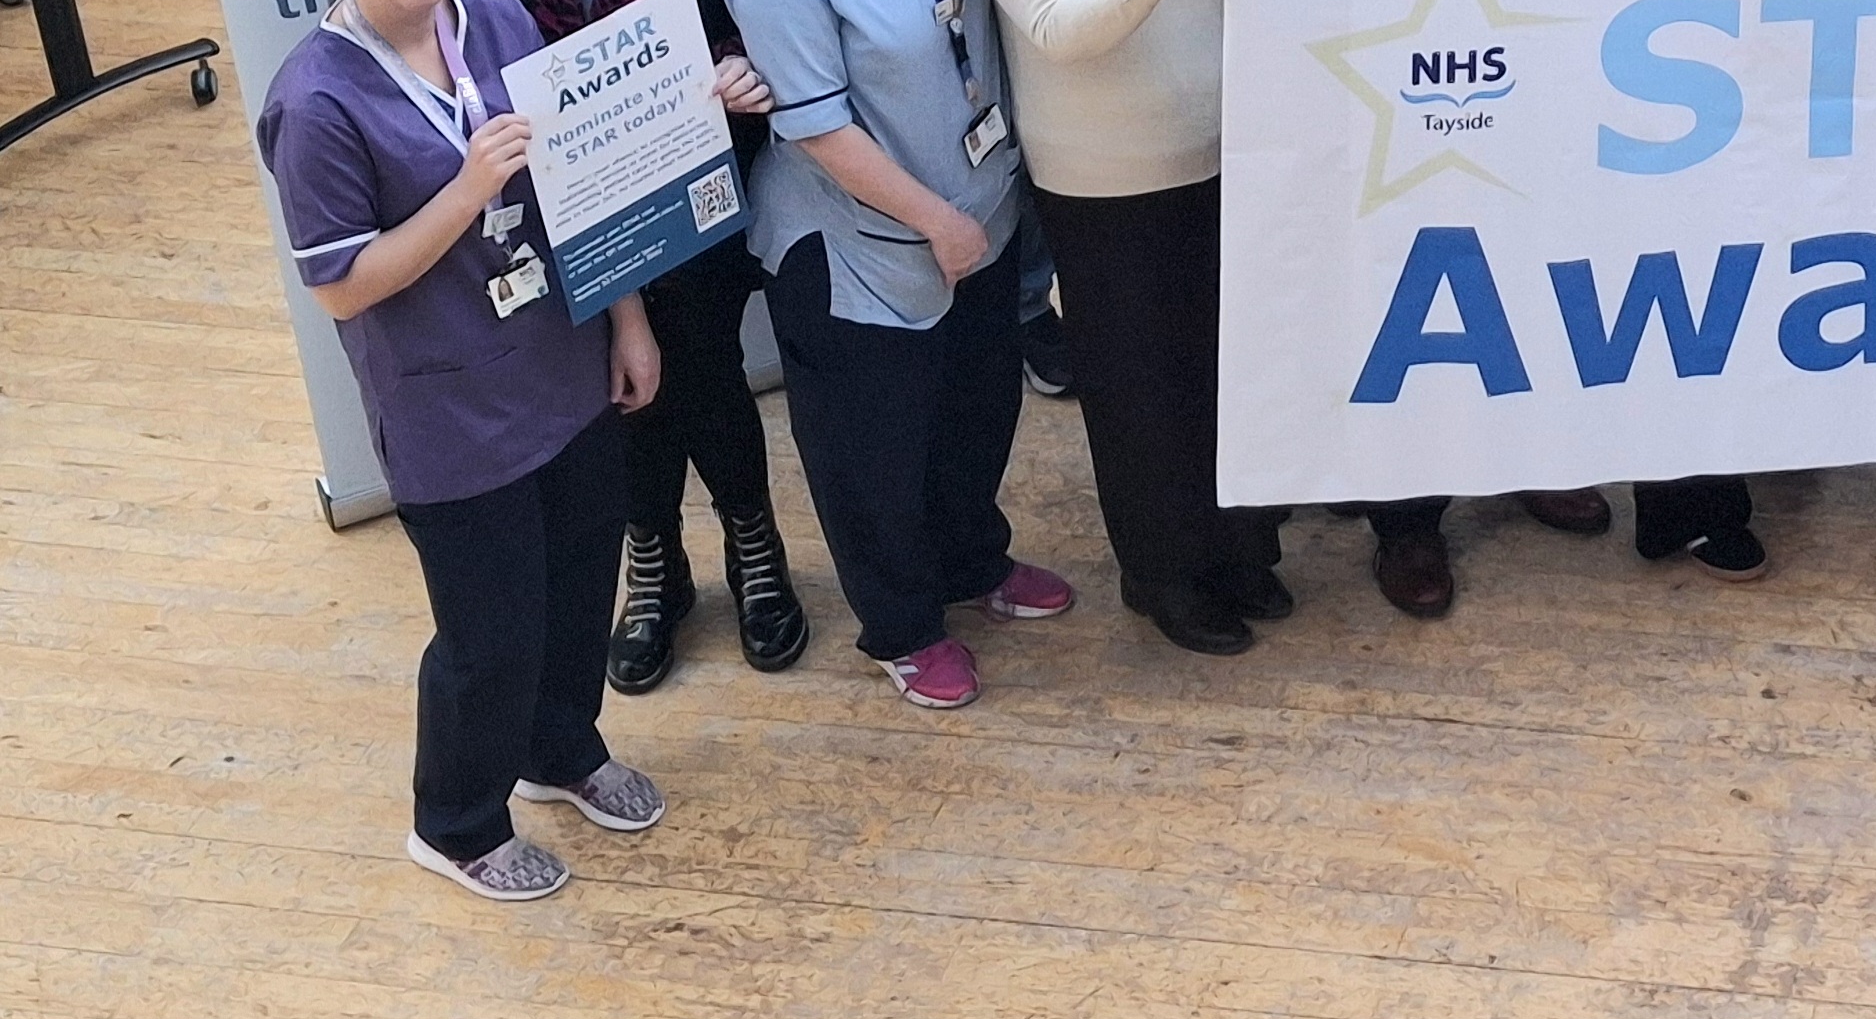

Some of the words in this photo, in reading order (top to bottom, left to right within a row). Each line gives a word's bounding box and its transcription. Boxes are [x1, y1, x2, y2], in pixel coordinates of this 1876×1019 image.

[558, 38, 671, 114] Awards
[574, 15, 657, 75] STAR
[1412, 46, 1507, 86] NHS
[546, 91, 644, 153] Nominate
[649, 63, 694, 99] your
[565, 128, 619, 166] STAR
[624, 89, 685, 134] today!
[1422, 111, 1494, 137] Tayside
